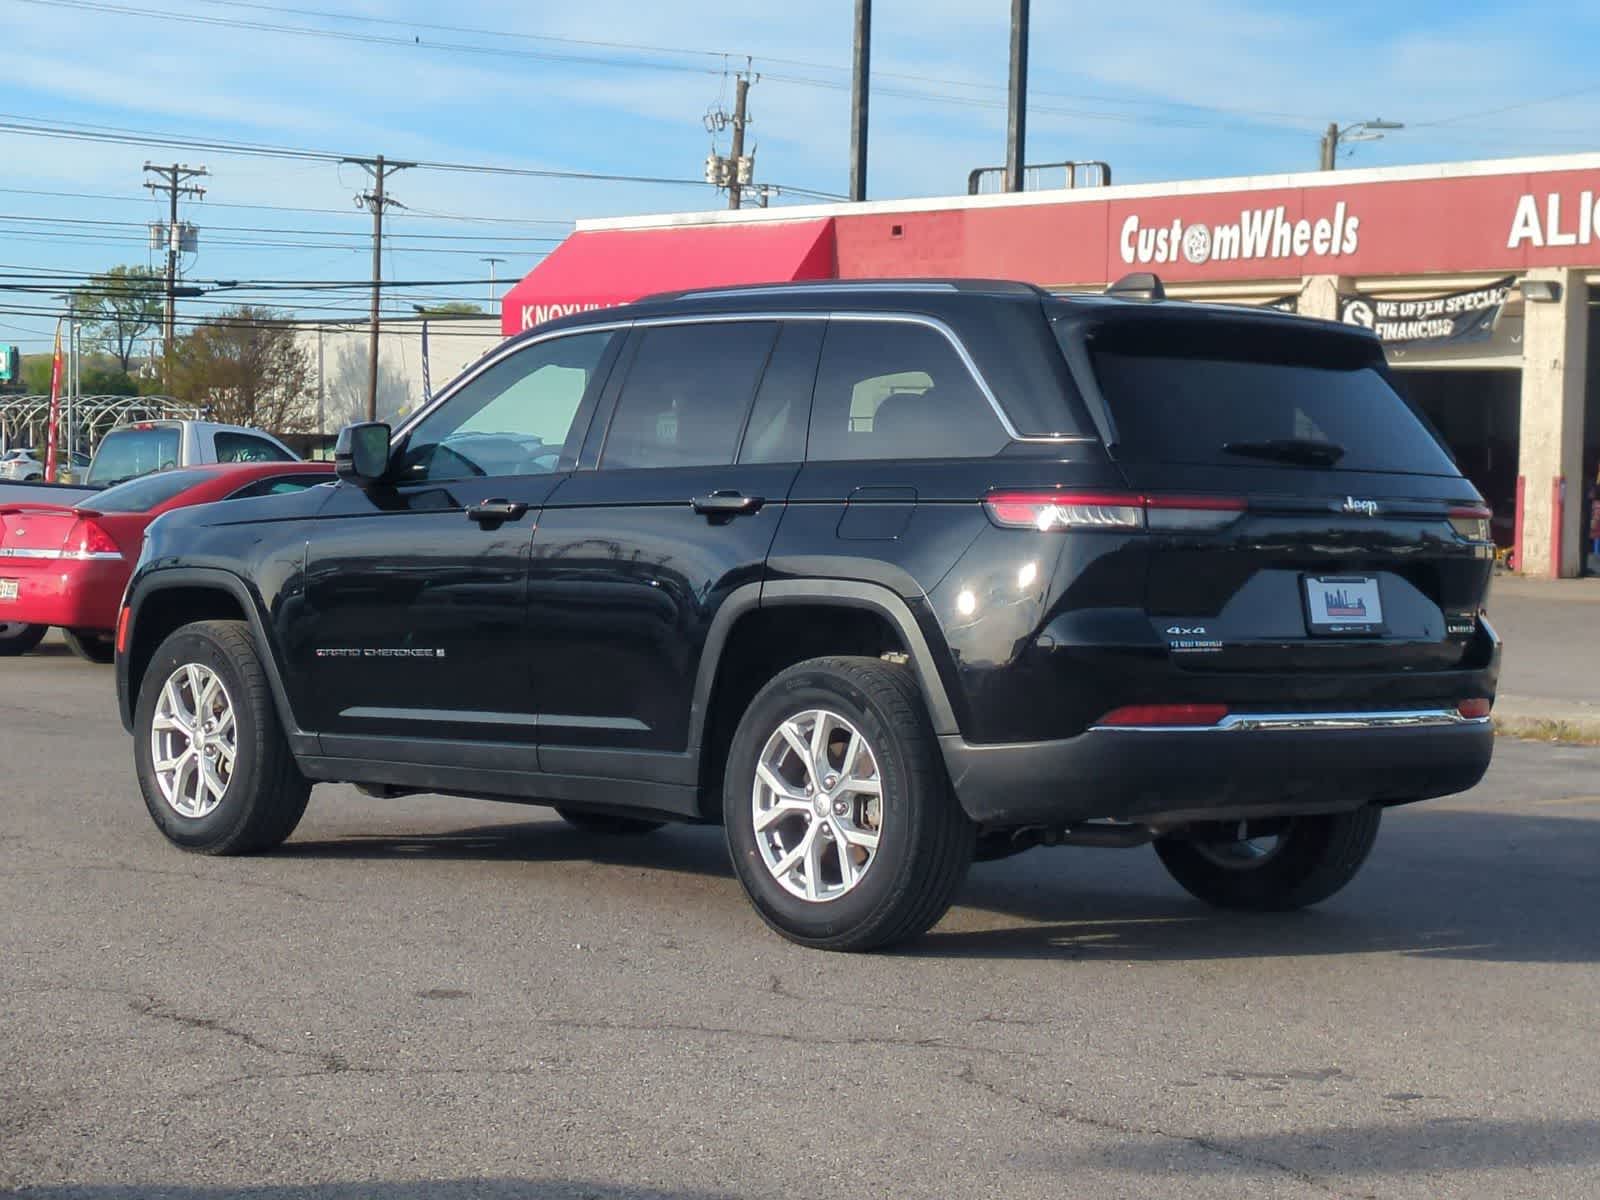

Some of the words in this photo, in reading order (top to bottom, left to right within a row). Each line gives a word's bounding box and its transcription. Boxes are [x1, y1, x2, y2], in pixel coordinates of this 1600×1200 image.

[1506, 190, 1600, 249] ALI
[1376, 301, 1398, 317] WE
[1343, 495, 1378, 517] Jeep
[316, 648, 361, 657] GRAND
[363, 648, 433, 657] CHEROKEE
